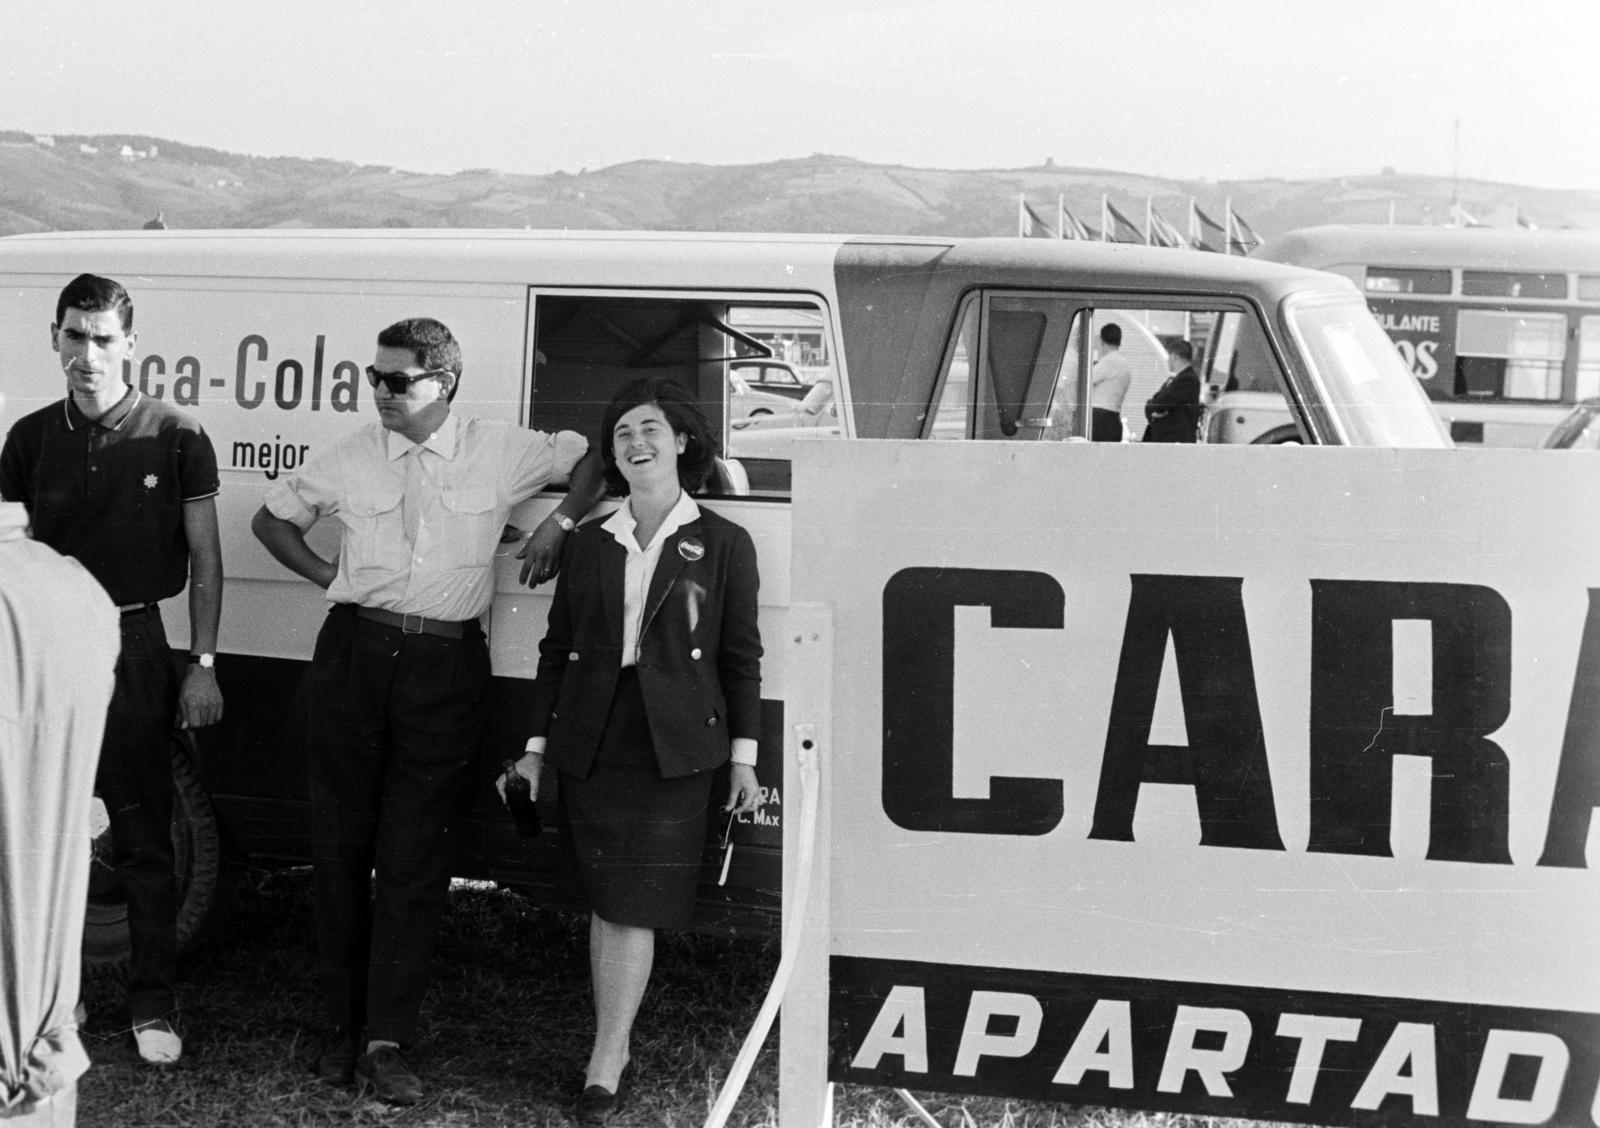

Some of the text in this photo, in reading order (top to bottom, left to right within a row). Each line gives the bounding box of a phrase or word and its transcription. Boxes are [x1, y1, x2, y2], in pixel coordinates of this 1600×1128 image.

[232, 435, 309, 480] mejor
[757, 786, 780, 804] RA
[850, 985, 1600, 1128] APARTAD
